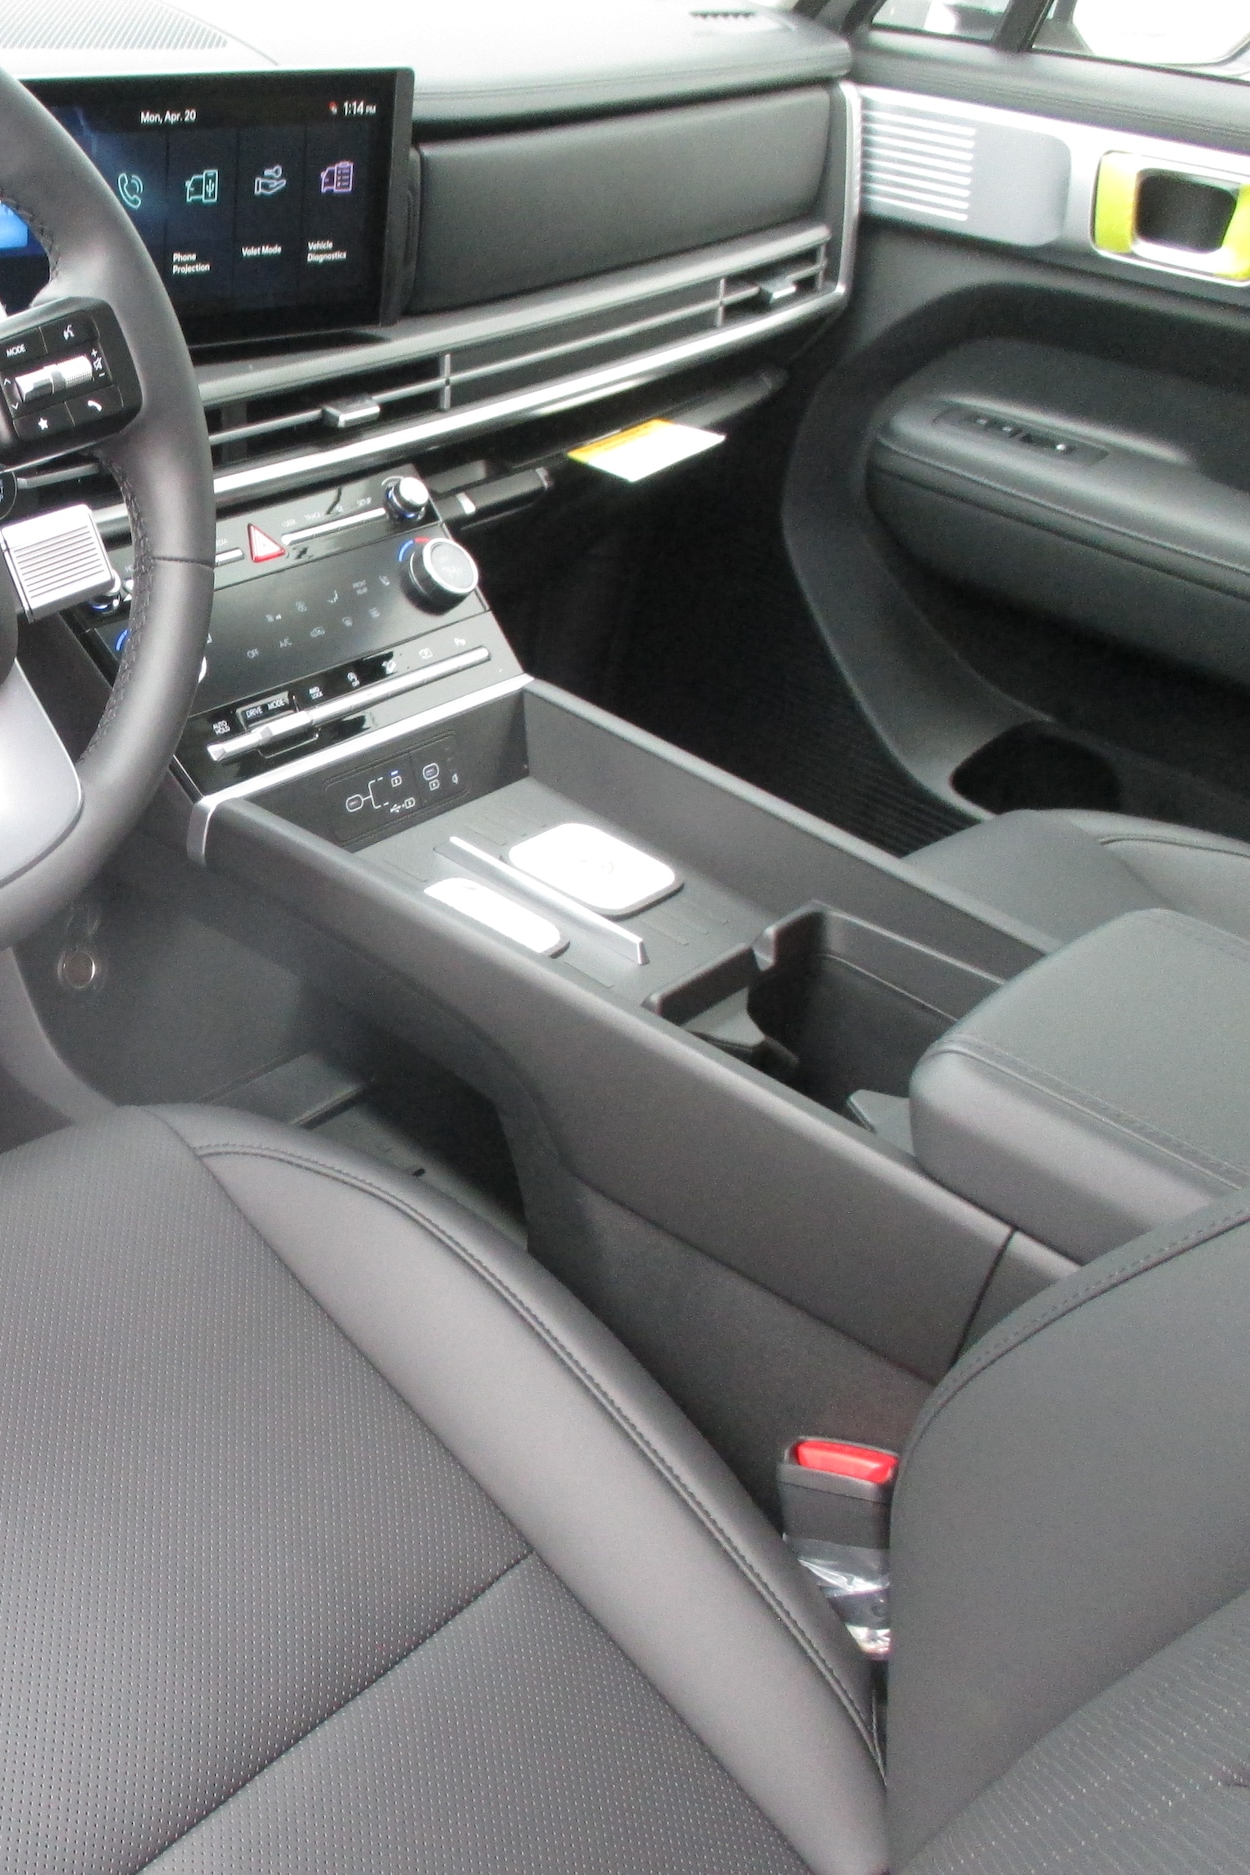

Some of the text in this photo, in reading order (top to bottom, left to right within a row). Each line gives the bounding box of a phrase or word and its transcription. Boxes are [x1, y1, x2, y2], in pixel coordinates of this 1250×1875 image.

[343, 101, 376, 114] 1:14 PM
[140, 109, 196, 123] Mon, Apr. 20
[241, 244, 281, 256] Valet Mode
[307, 240, 333, 250] Vehicle
[172, 252, 196, 262] Phone
[307, 250, 347, 263] Diagnostics
[172, 263, 210, 274] Projection
[6, 343, 26, 356] MODE
[245, 699, 285, 718] DRIVE MODE
[212, 720, 227, 729] AUTO
[214, 726, 230, 735] HOLD
